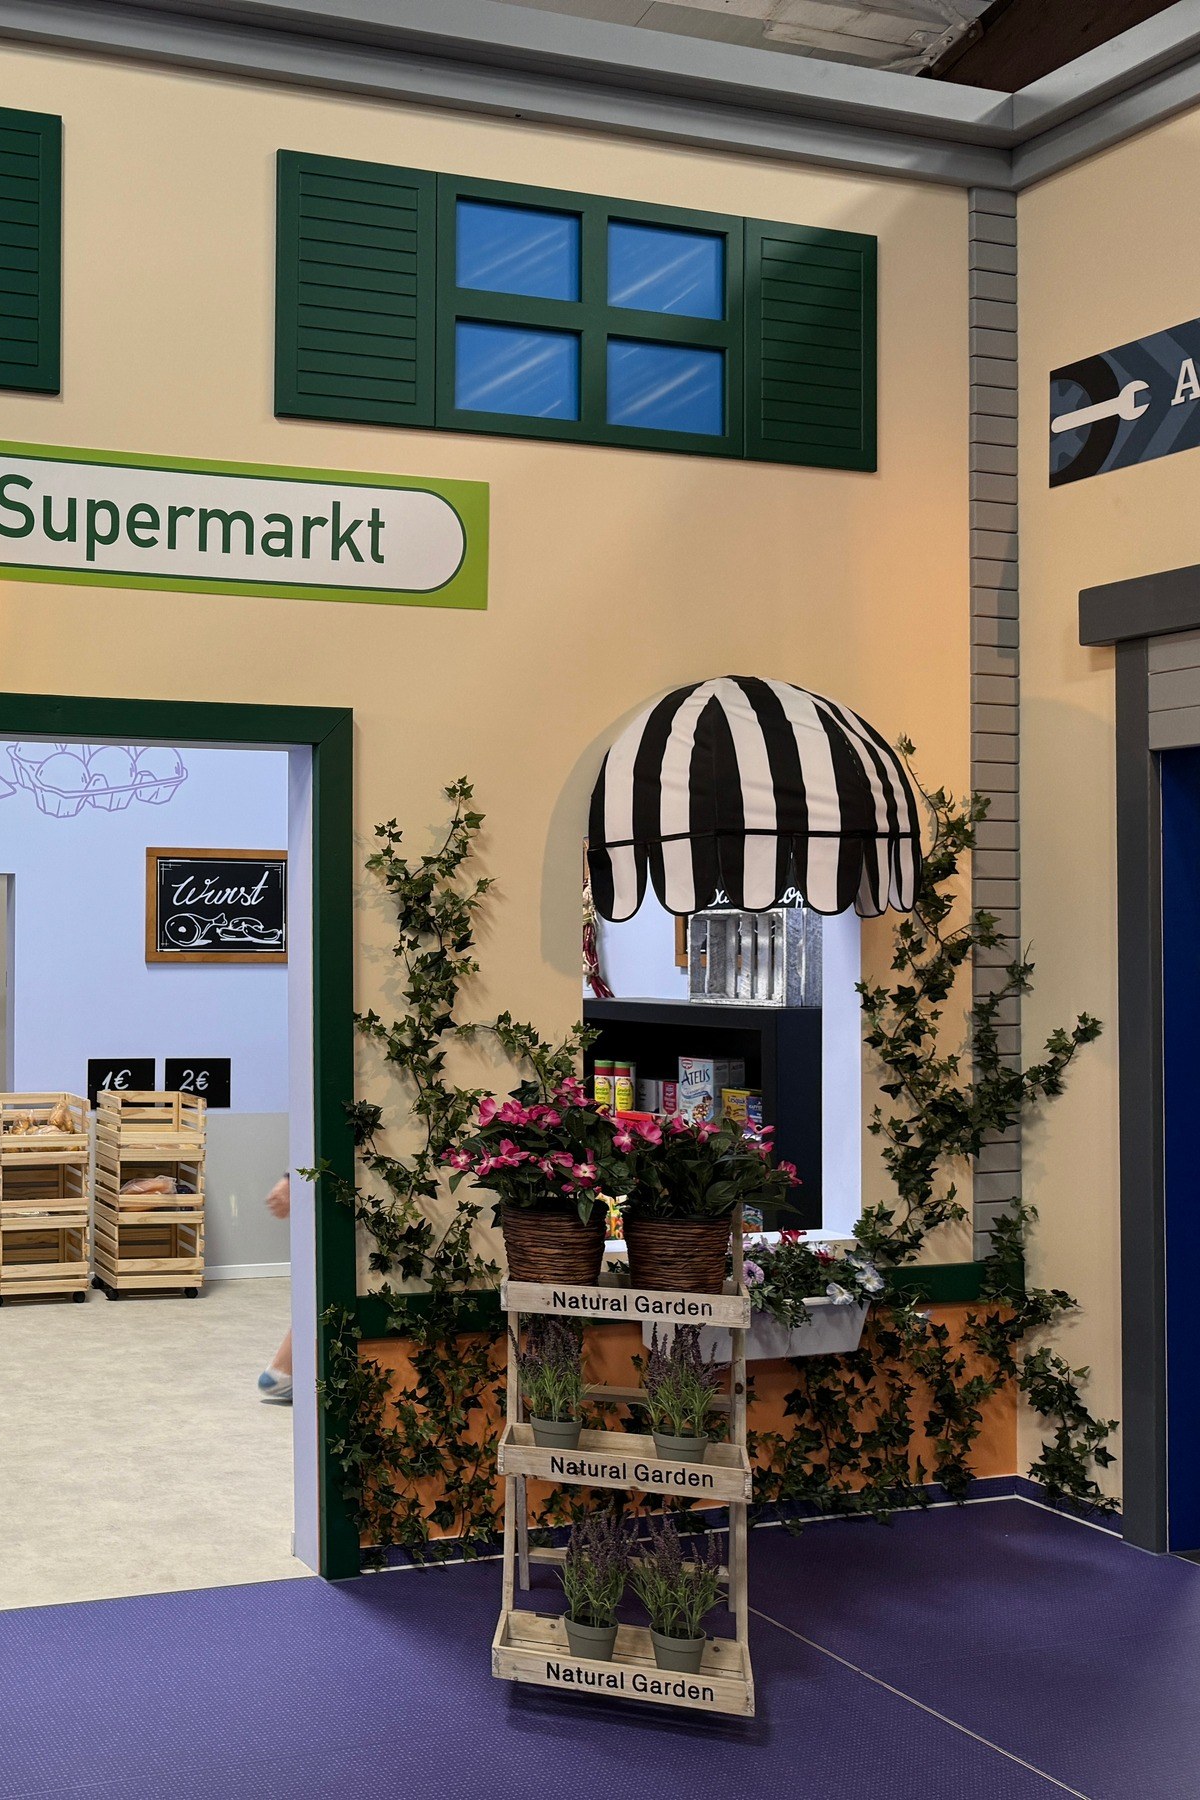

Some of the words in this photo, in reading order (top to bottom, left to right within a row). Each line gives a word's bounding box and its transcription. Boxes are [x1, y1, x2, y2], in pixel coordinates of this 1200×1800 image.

[171, 870, 270, 906] Wurst
[102, 1069, 132, 1091] 1€
[179, 1069, 210, 1091] 2€
[552, 1290, 628, 1312] Natural
[634, 1295, 713, 1317] Garden
[550, 1456, 627, 1480] Natural
[634, 1463, 714, 1488] Garden
[546, 1661, 625, 1690] Natural
[632, 1673, 714, 1702] Garden
